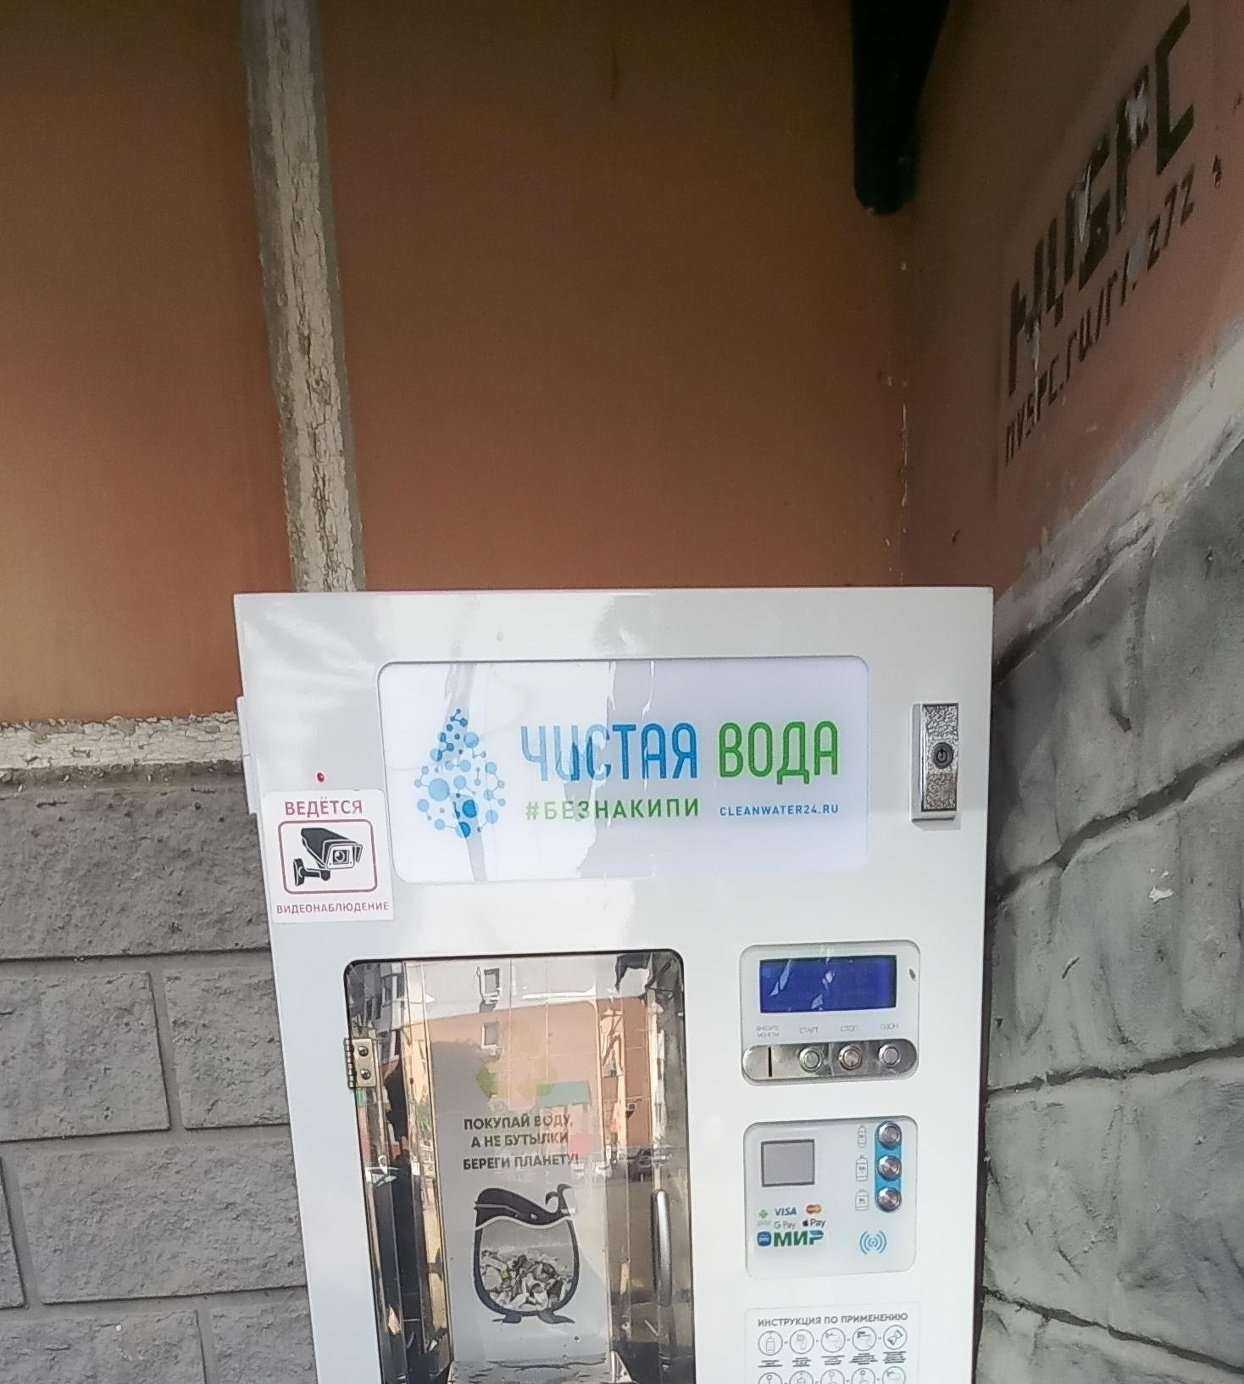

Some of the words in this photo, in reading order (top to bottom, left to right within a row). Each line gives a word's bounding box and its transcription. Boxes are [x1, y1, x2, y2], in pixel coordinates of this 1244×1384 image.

[520, 722, 698, 783] ЧИСТАЯ
[718, 721, 839, 785] ВОДА
[284, 795, 363, 818] ВЕДЁТСЯ
[525, 797, 700, 821] #БЕЗНАКИПИ
[719, 803, 840, 817] CLEANWATER24.RU
[276, 901, 390, 915] ВИДЕОНАБЛЮДЕНИЕ
[463, 1113, 531, 1131] ПОКУПАЙ
[471, 1136, 481, 1148] А
[484, 1135, 501, 1148] НЕ
[504, 1131, 569, 1147] БУТЫЛКИ
[463, 1155, 511, 1170] БЕРЕГИ
[514, 1153, 579, 1168] ПЛАНЕТУ!
[774, 1206, 798, 1216] VISA
[810, 1218, 826, 1228] Pay
[773, 1230, 825, 1247] МИР
[757, 1317, 822, 1328] ИНСТРУКЦИЯ
[823, 1316, 839, 1325] ПО
[840, 1312, 909, 1324] ПРИМЕНЕНИЮ
